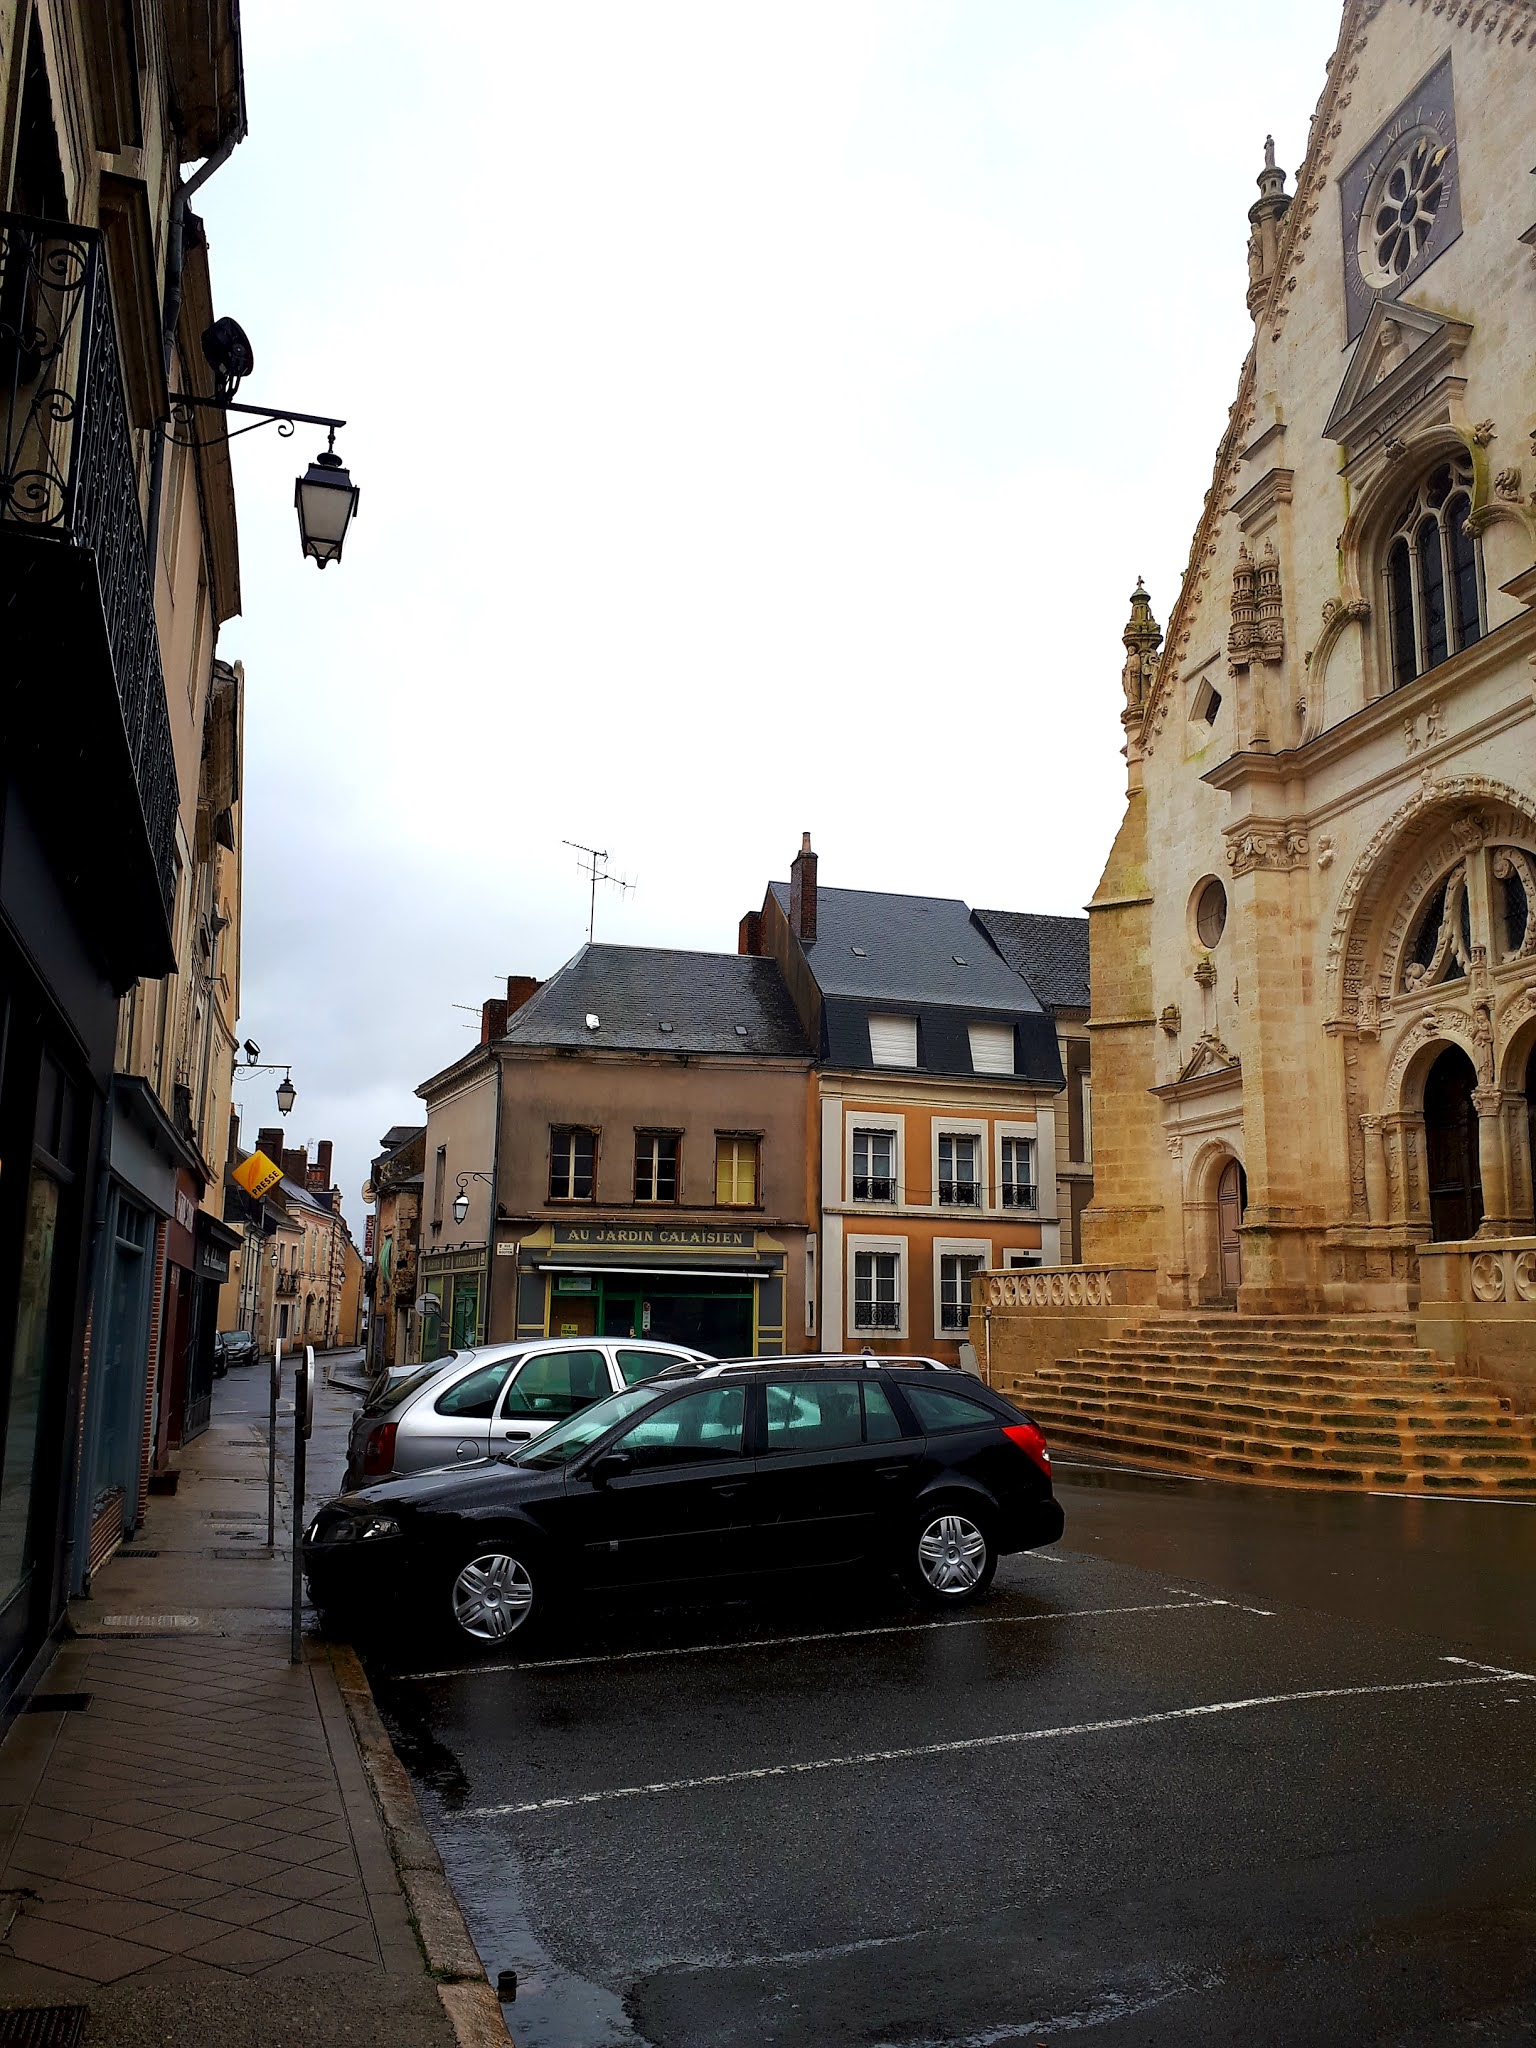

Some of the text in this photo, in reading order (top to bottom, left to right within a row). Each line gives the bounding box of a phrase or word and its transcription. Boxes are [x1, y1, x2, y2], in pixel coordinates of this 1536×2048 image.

[251, 1170, 280, 1196] PRESSE
[567, 1229, 743, 1244] AU JARDIN CALAISIEN
